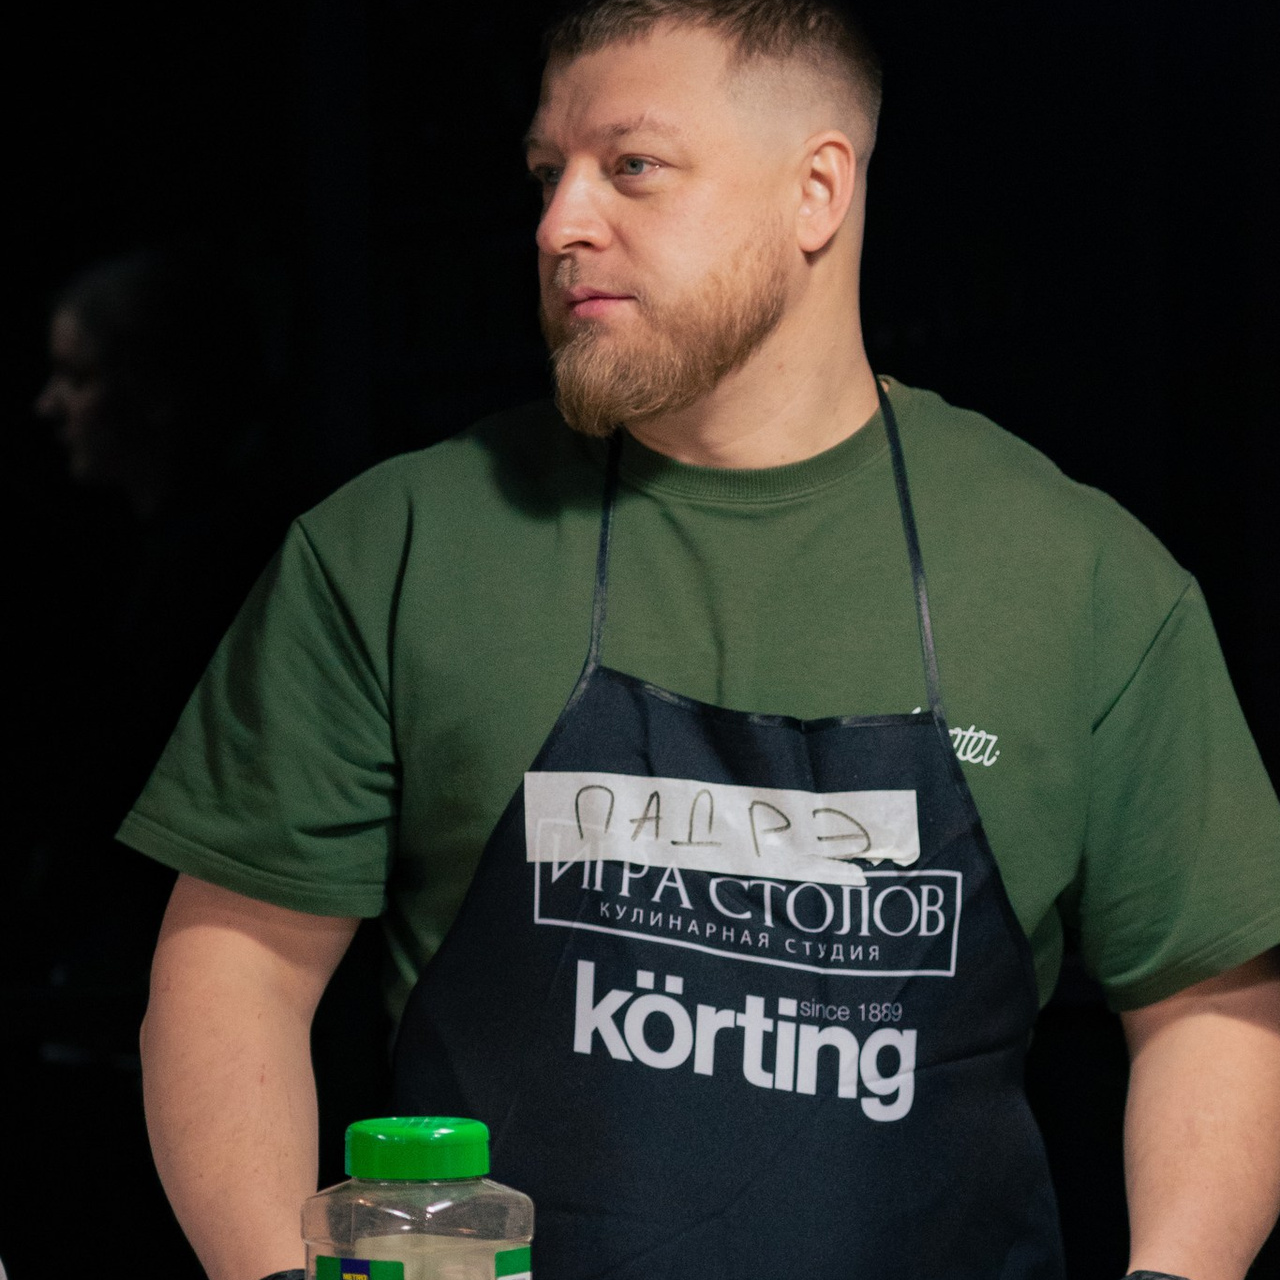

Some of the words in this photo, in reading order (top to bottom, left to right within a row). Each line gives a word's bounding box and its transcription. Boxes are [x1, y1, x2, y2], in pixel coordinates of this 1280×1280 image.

[575, 784, 871, 860] ПАДРЭ
[600, 901, 770, 948] КУЛИНАРНАЯ
[785, 938, 881, 962] СТУДИЯ
[709, 877, 946, 937] СТОЛОВ
[573, 960, 918, 1122] körting
[800, 999, 850, 1022] since
[858, 1002, 903, 1022] 1889
